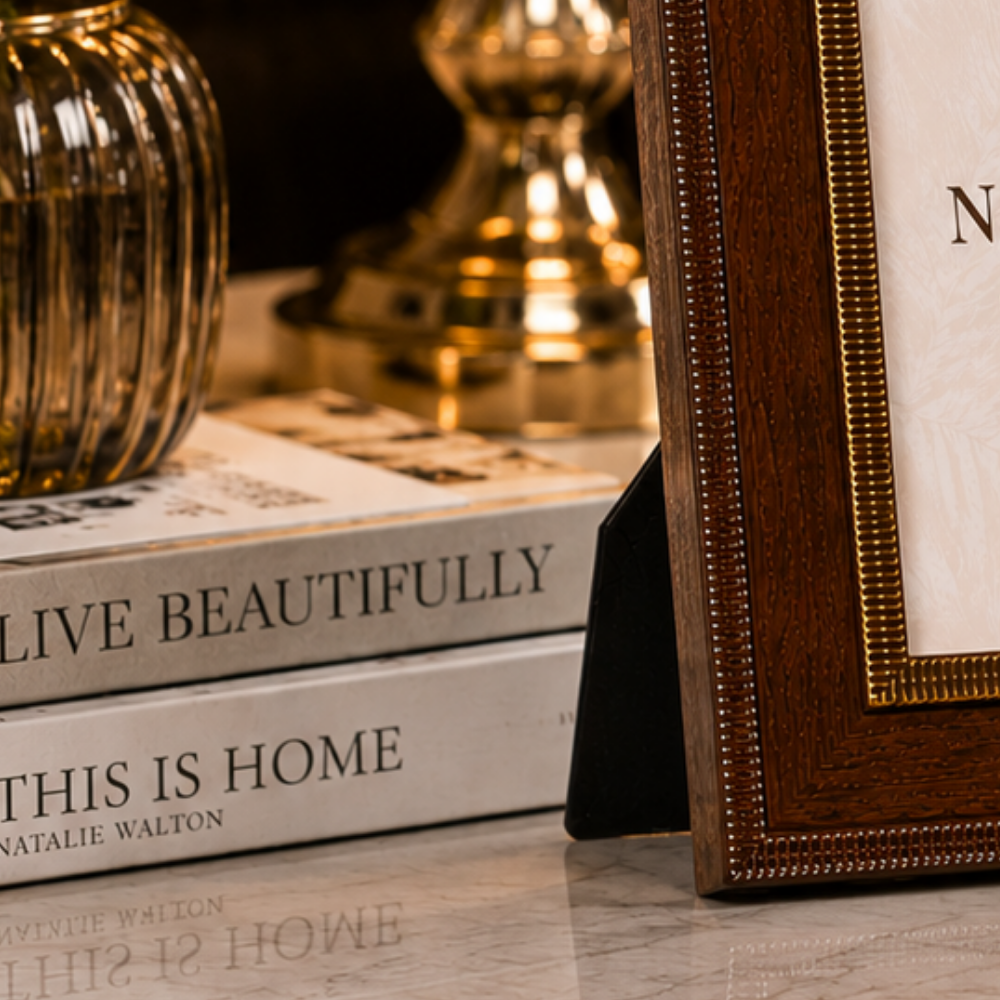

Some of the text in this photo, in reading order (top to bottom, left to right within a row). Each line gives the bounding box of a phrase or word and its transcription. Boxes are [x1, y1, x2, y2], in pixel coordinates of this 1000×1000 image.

[0, 544, 555, 665] LIVE BEAUTIFULLY
[0, 725, 404, 823] THIS IS HOME
[114, 809, 224, 841] WALTON
